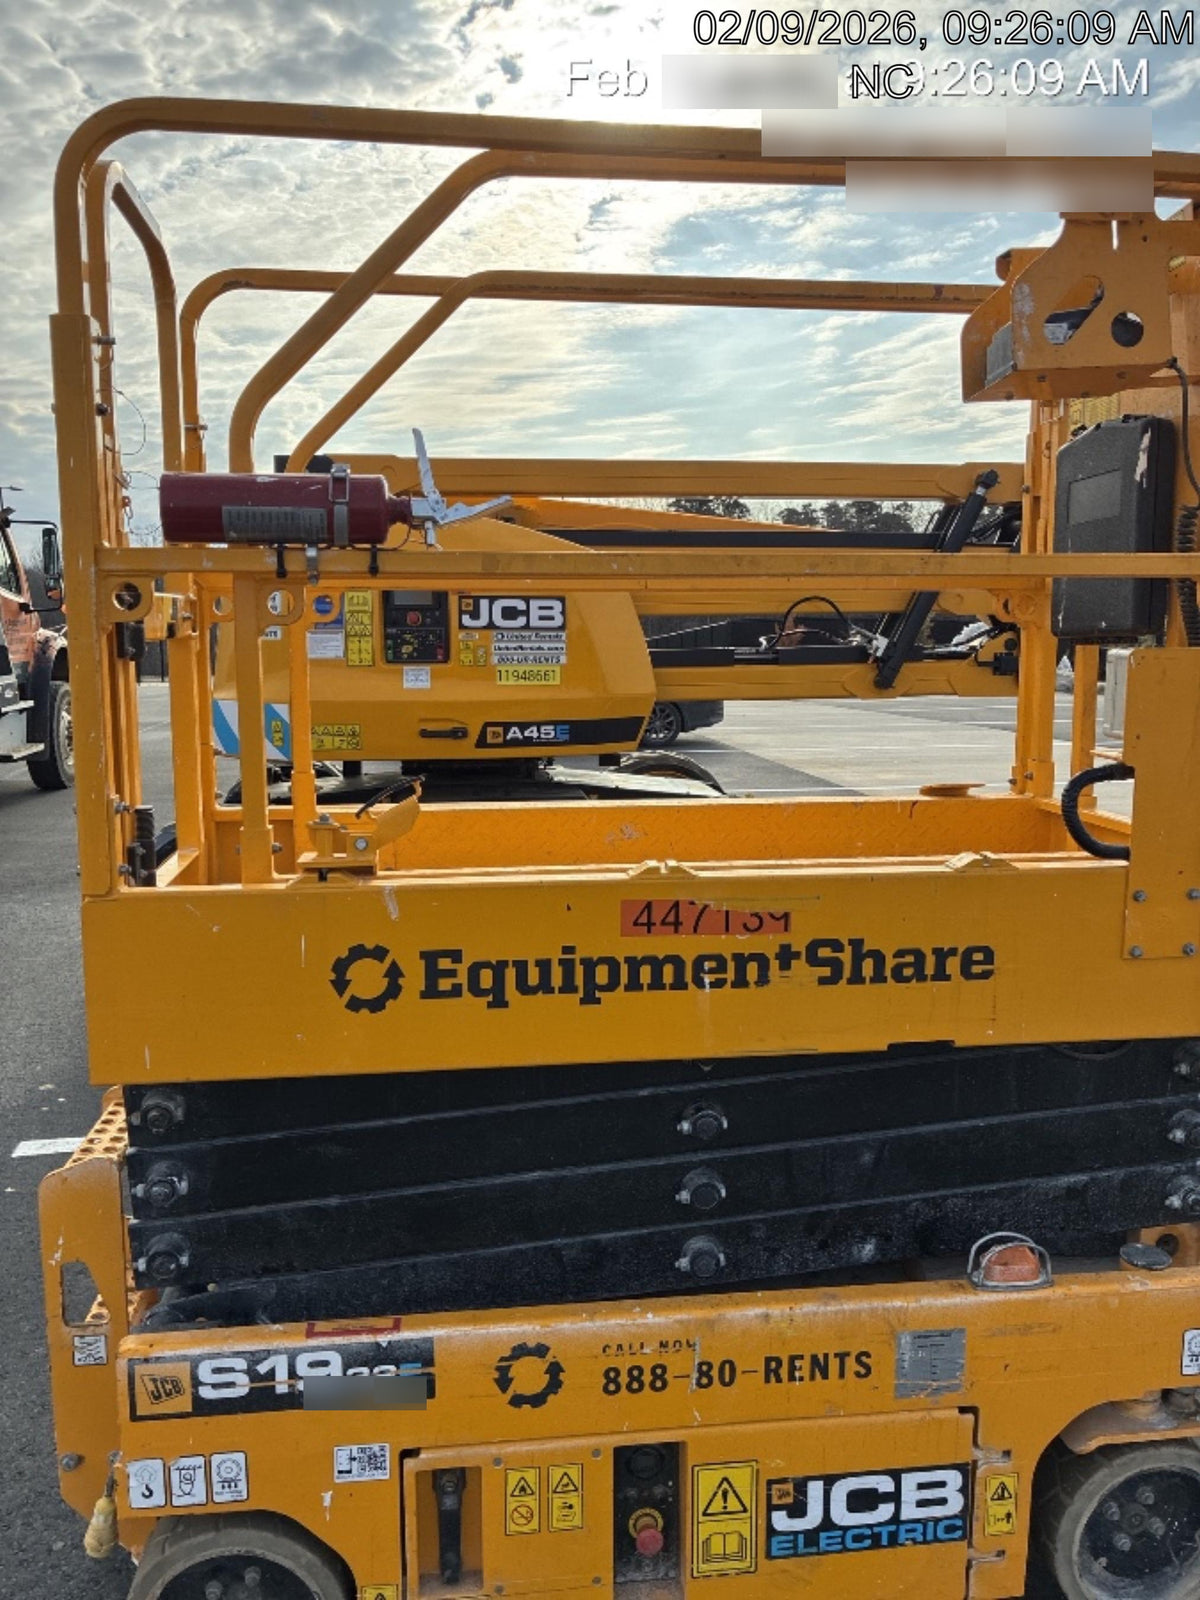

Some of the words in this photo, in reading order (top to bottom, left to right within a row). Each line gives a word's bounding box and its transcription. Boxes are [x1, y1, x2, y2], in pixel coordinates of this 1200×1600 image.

[462, 598, 564, 628] JCB
[506, 725, 569, 740] A45E
[420, 938, 995, 1009] EquipmentShare
[149, 1377, 182, 1401] JCB
[602, 1350, 872, 1396] 888-80-RENTS
[771, 1469, 965, 1531] JCB
[770, 1518, 964, 1557] ELECTRIC
